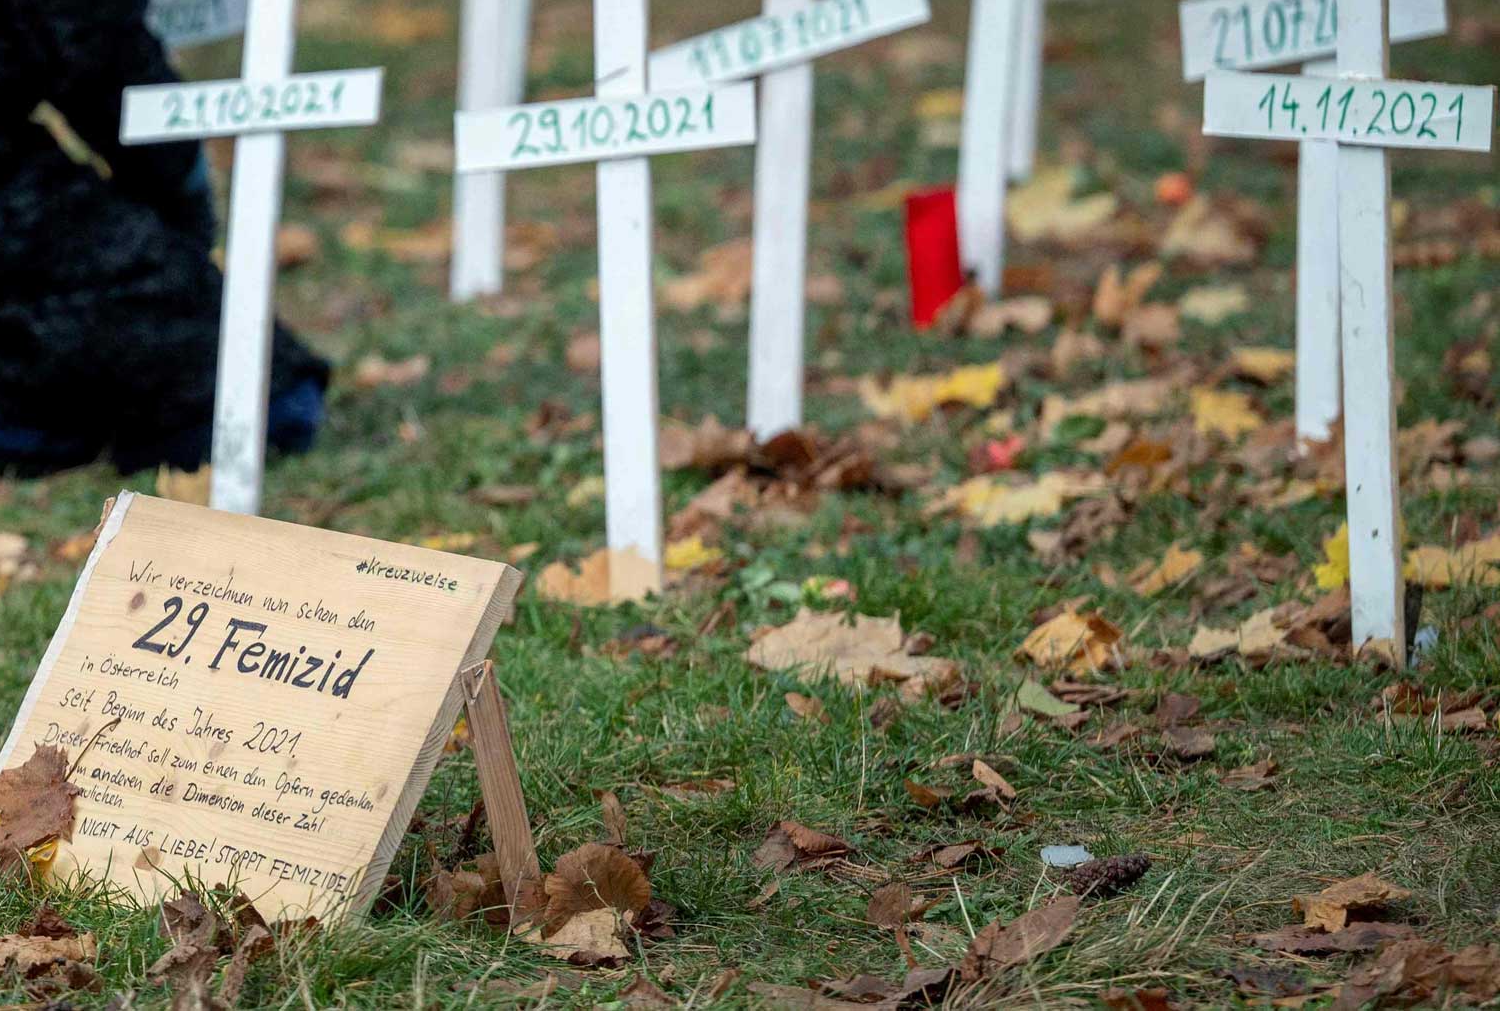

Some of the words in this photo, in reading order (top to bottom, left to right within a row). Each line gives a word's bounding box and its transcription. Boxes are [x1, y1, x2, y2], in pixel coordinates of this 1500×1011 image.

[1258, 82, 1464, 141] 14.11.2021
[128, 560, 162, 584] Wir
[169, 575, 254, 607] verzeichnen
[262, 595, 289, 615] nun
[347, 609, 376, 632] den
[80, 655, 94, 673] in
[100, 652, 180, 690] Österreich
[131, 596, 210, 666] 29.
[207, 617, 376, 699] Femizid
[59, 687, 96, 713] seit
[101, 690, 146, 732] Beginn
[151, 707, 178, 732] des
[185, 706, 234, 744] Jahres
[242, 721, 302, 759] 2021.
[43, 722, 89, 748] Dieser
[92, 733, 149, 760] Friedhof
[147, 747, 170, 767] soll
[170, 754, 198, 772] zum
[202, 760, 238, 782] einen
[243, 766, 267, 788] den
[275, 771, 315, 803] Opfern
[90, 767, 143, 792] anderen
[150, 775, 175, 797] die
[182, 782, 246, 814] Dimension
[251, 801, 291, 825] dieser
[293, 812, 326, 833] Zahl
[78, 816, 120, 840] NICHT
[122, 824, 154, 848] AUS
[159, 836, 218, 863] LIEBE!
[215, 844, 267, 872] STOPPT
